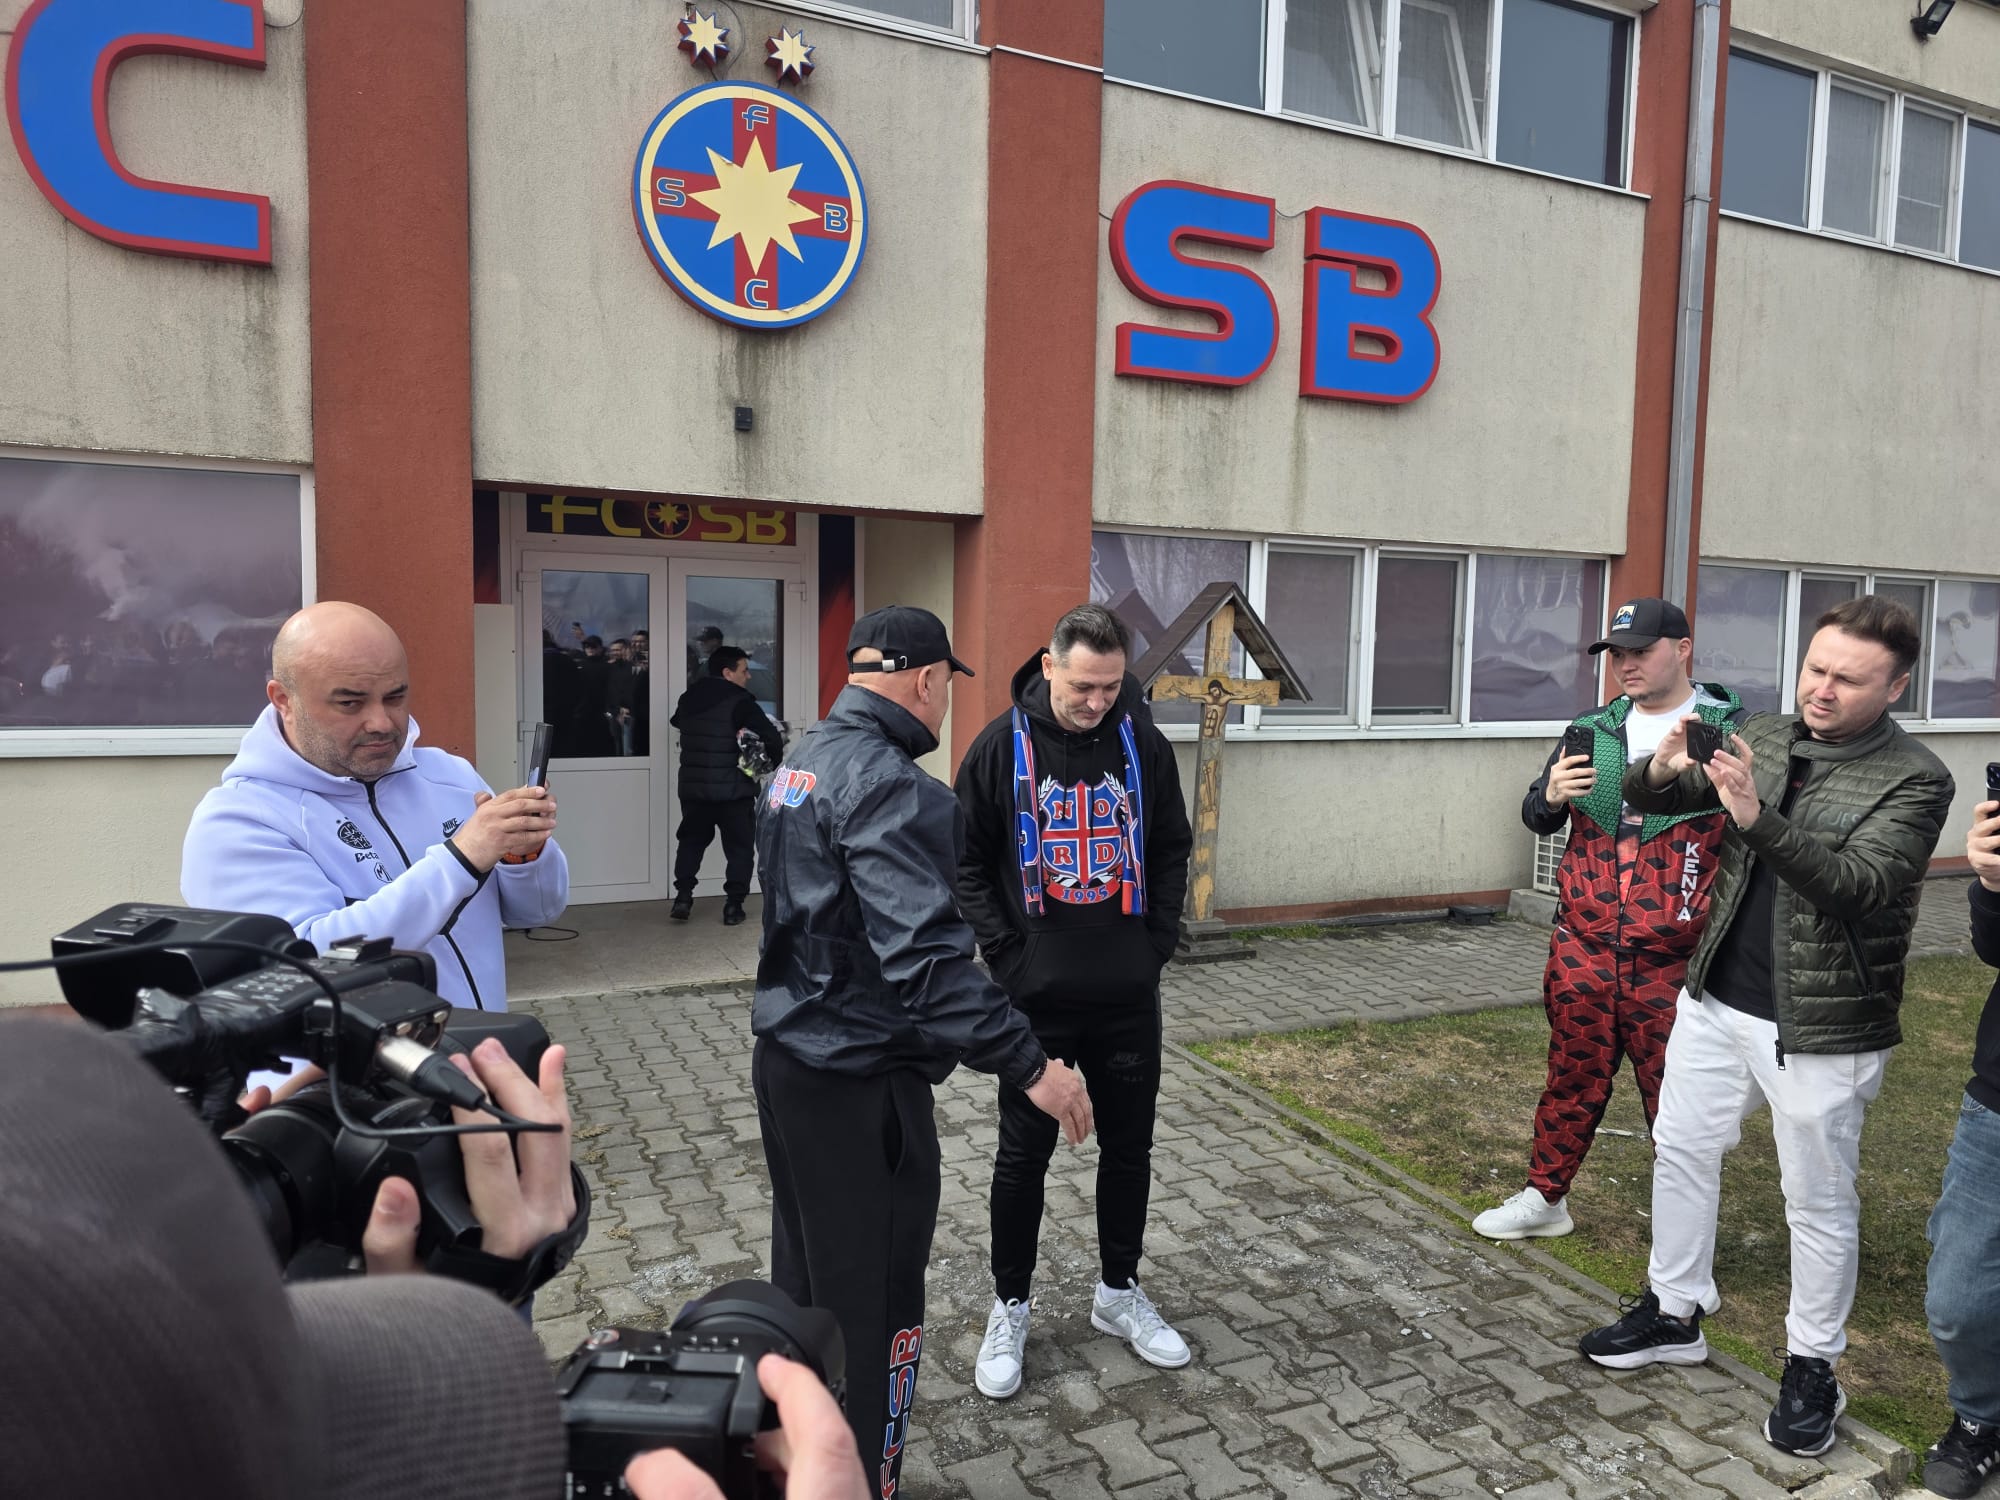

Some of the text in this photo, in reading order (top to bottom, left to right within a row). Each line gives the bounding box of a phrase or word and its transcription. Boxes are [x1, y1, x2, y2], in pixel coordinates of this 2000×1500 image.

[5, 0, 272, 268] C
[656, 177, 849, 233] S B
[745, 279, 769, 309] C
[1109, 179, 1442, 405] SB
[1061, 884, 1109, 903] 1995
[1677, 841, 1701, 921] KENYA
